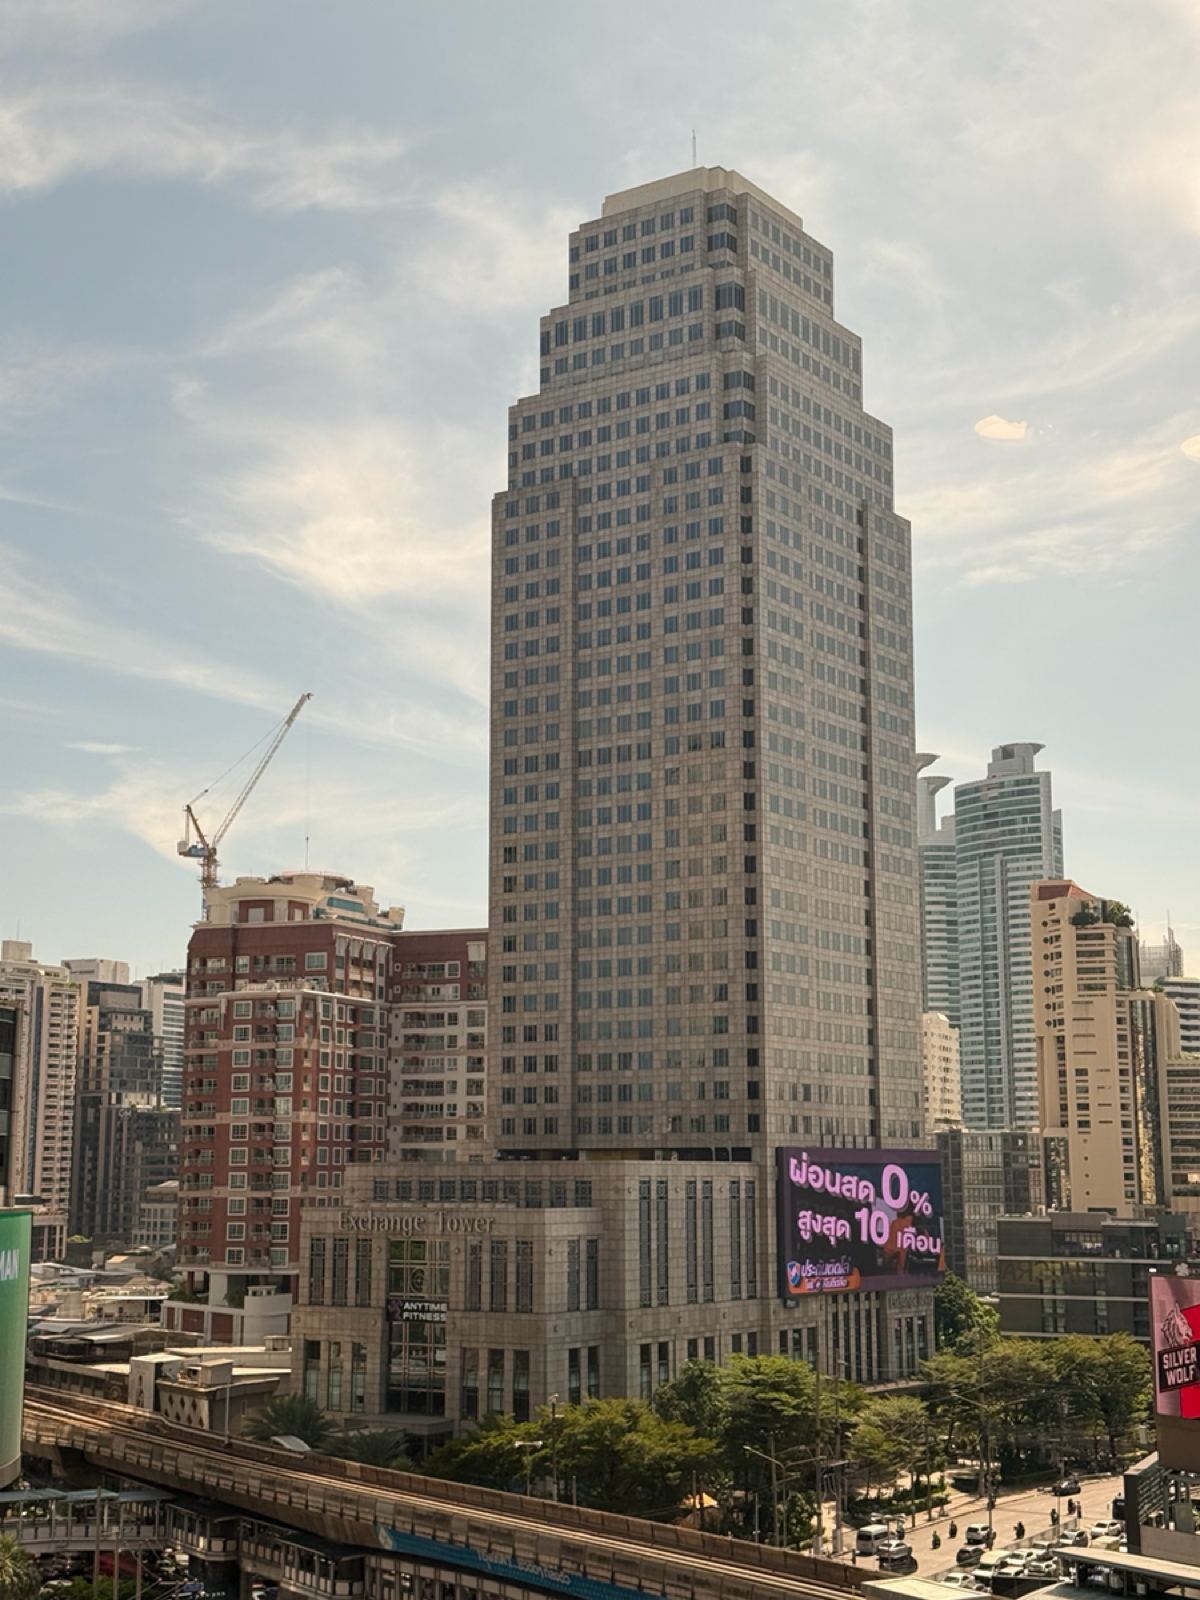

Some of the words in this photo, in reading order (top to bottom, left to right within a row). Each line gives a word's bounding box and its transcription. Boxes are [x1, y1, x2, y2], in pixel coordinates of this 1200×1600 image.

[789, 1152, 874, 1204] ผ่อนสด
[882, 1164, 932, 1216] 0%
[338, 1210, 425, 1237] Exchange
[435, 1210, 494, 1233] Tower
[797, 1210, 851, 1246] สูงสุด
[855, 1207, 889, 1245] 10
[897, 1226, 941, 1254] เดือน
[402, 1312, 446, 1321] FITNESS
[403, 1302, 448, 1312] ANYTIME
[1162, 1347, 1197, 1369] SILVER
[1165, 1365, 1196, 1386] WOLF
